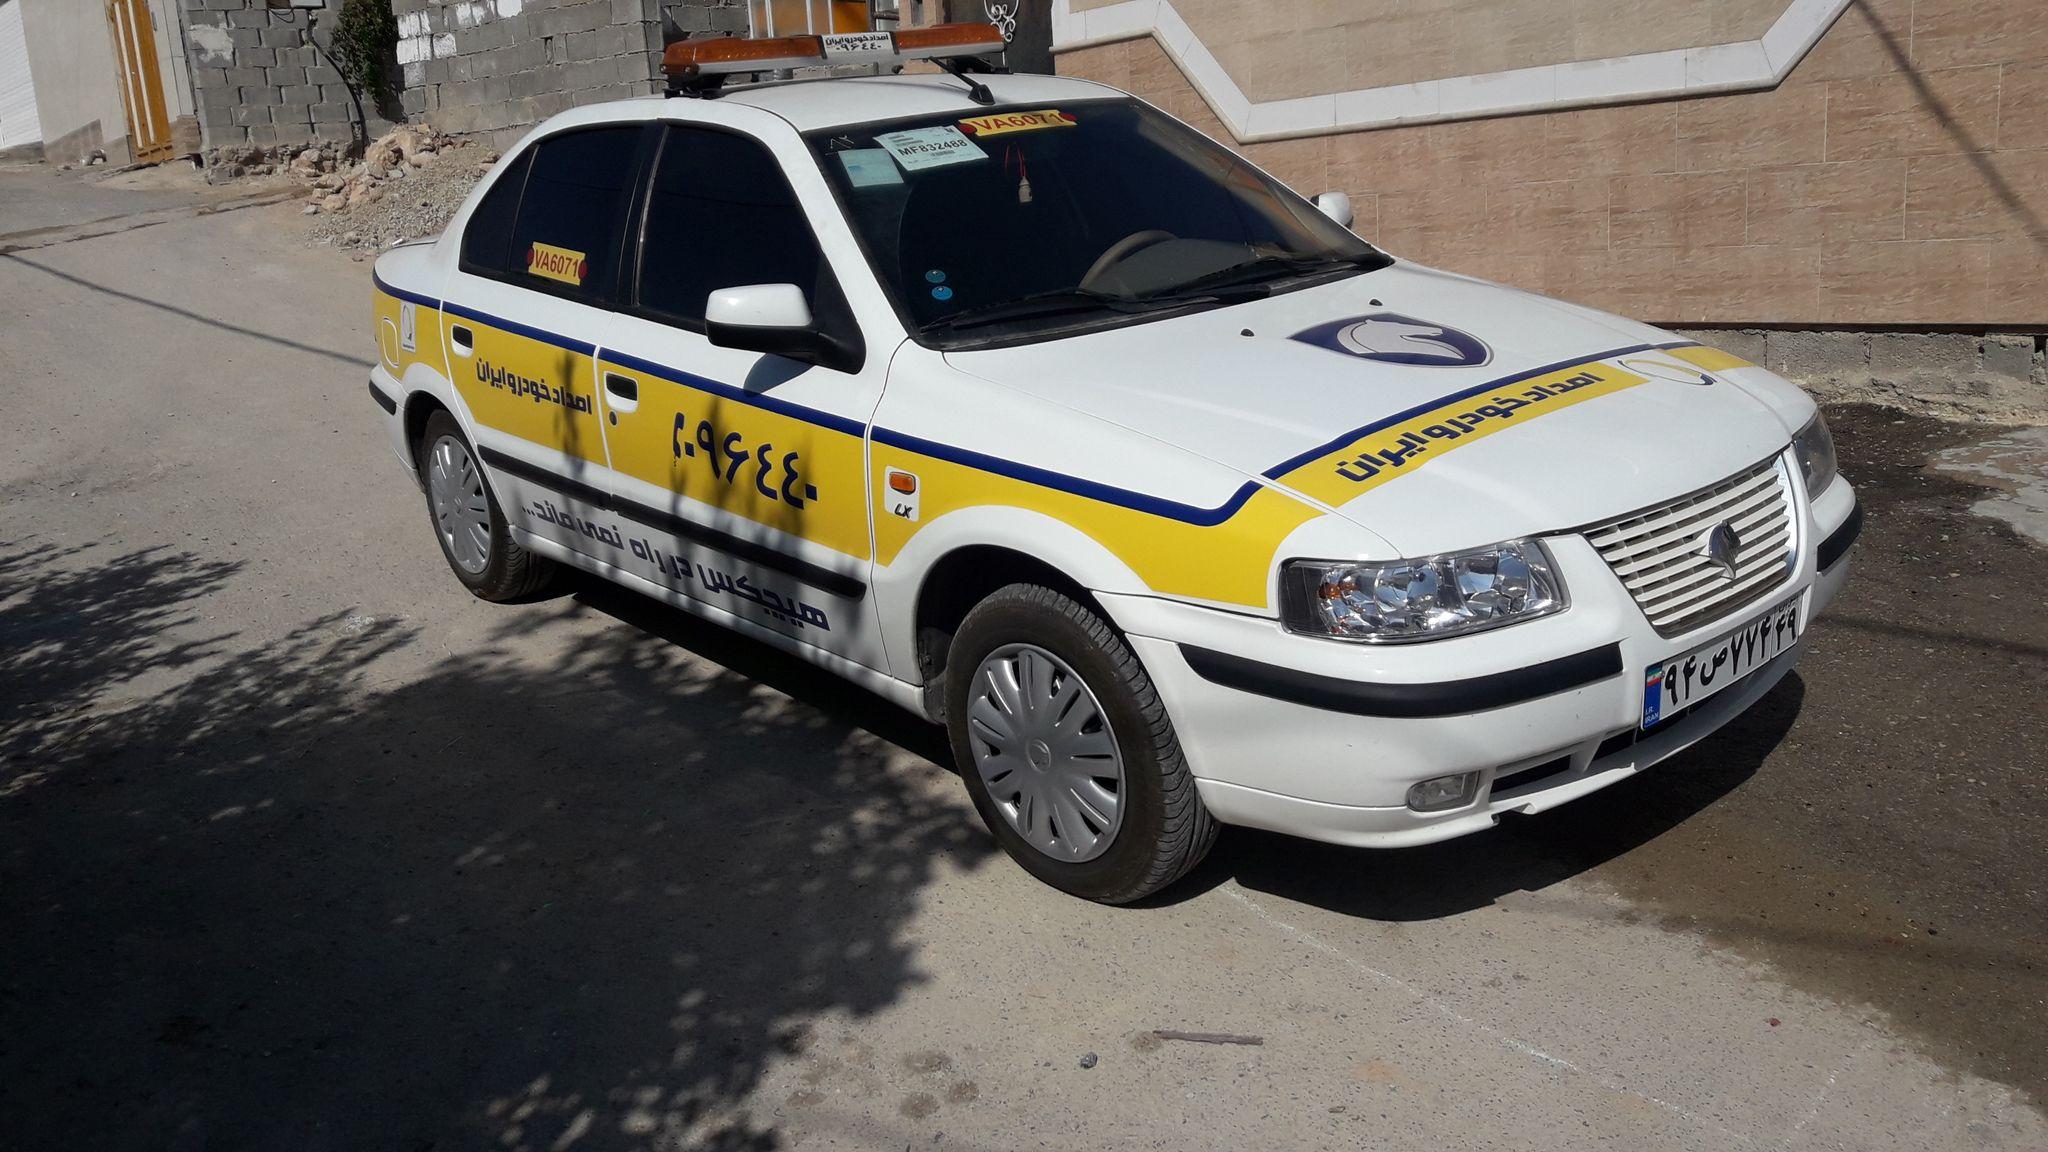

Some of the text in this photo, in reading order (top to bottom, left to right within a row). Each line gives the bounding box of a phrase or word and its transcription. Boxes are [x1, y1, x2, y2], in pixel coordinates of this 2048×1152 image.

[970, 112, 1065, 131] VA6071
[897, 139, 968, 157] MF832488
[533, 252, 580, 279] VA6071
[475, 357, 593, 415] امداد خودرو ایران
[1334, 371, 1606, 483] امداد خودرو ایران
[893, 503, 913, 519] LX
